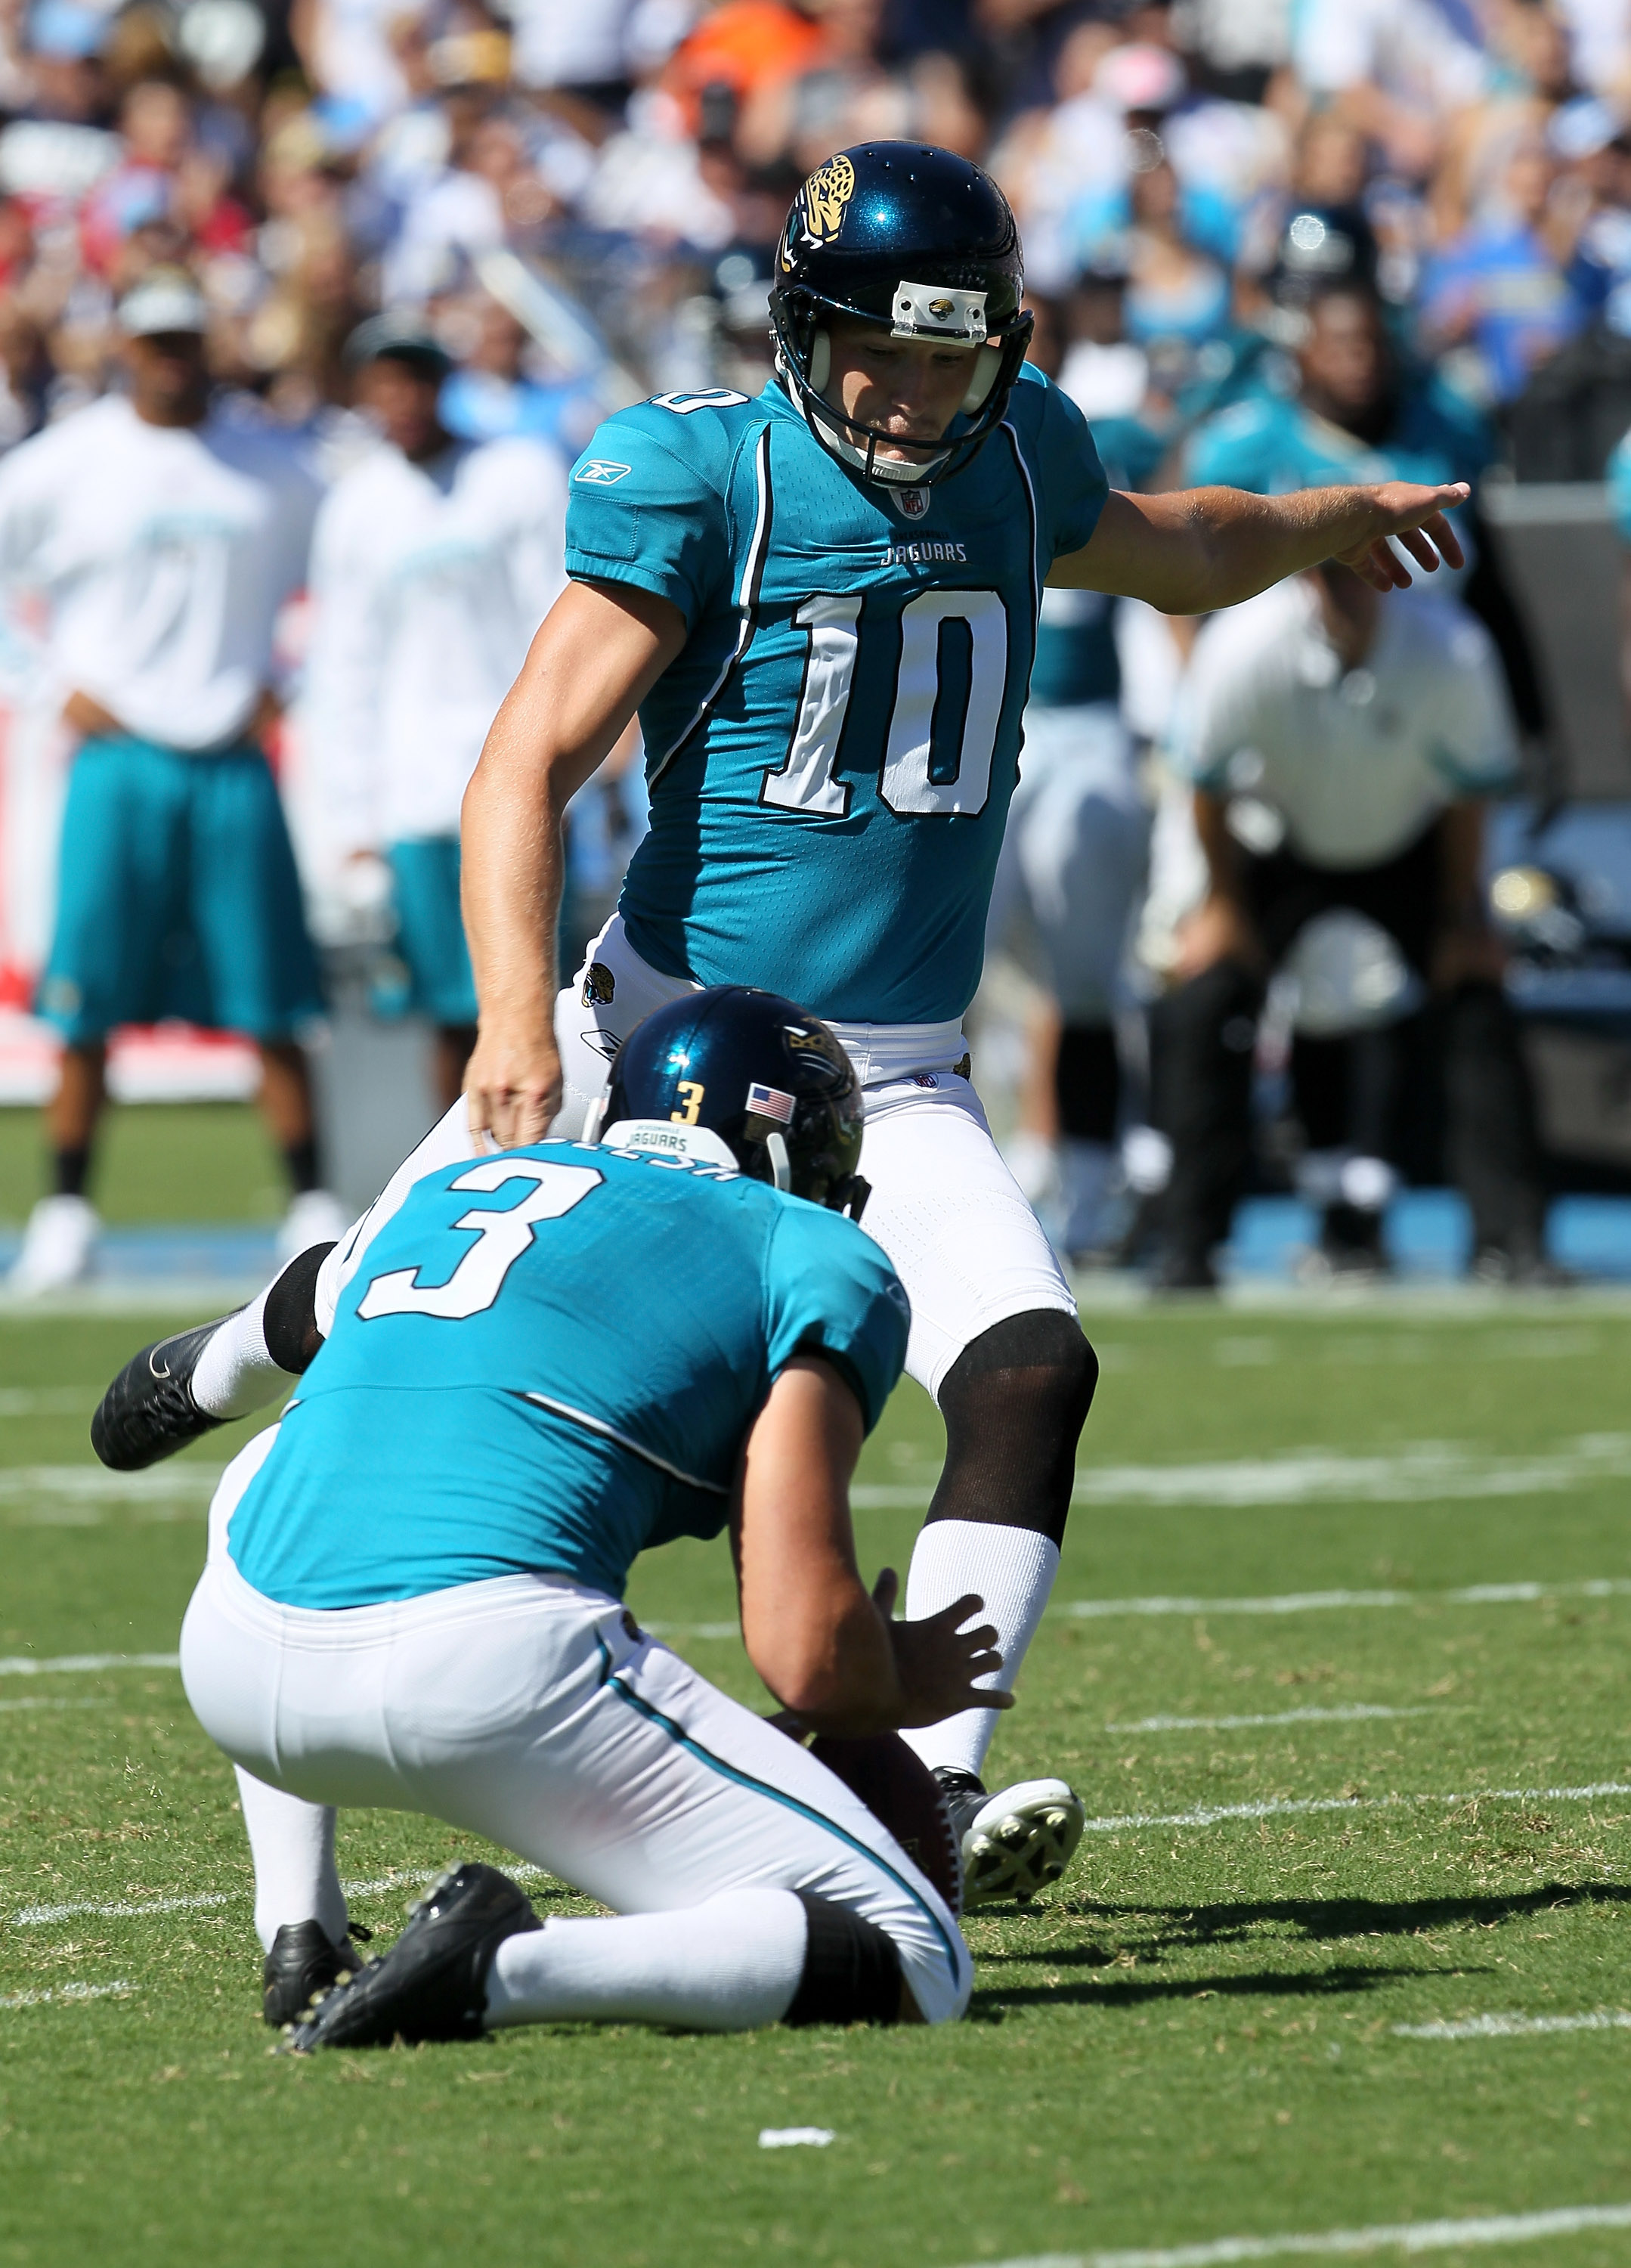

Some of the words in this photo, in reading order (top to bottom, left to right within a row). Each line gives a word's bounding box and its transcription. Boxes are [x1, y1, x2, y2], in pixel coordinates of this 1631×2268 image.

[904, 499, 923, 512] NFL
[880, 542, 967, 565] JAGUARS
[758, 585, 1010, 818] 10
[670, 1080, 705, 1126] 3
[355, 1157, 606, 1321] 3
